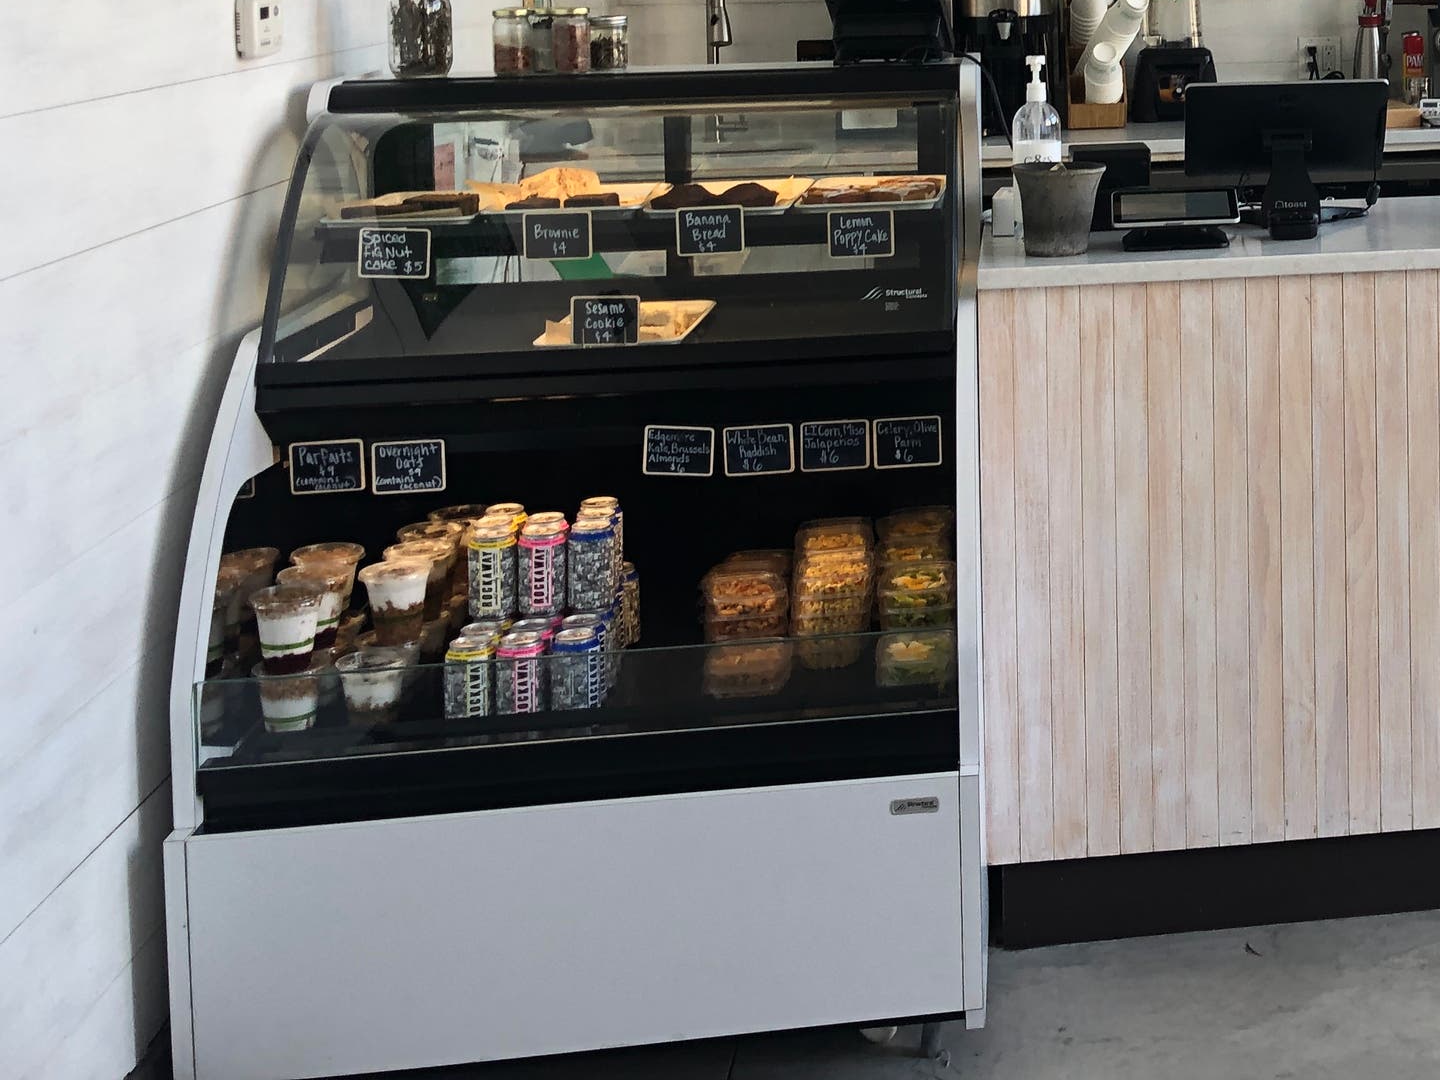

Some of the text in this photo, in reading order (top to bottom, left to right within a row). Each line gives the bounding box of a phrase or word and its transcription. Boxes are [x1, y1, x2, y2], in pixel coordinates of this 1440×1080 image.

[685, 211, 731, 228] Banana
[840, 216, 874, 229] Lemon
[534, 223, 580, 240] Brownie
[692, 226, 727, 241] Bread
[864, 228, 889, 244] Cake
[385, 245, 413, 259] Nut
[403, 260, 424, 275] $5
[885, 287, 922, 297] Structural
[585, 301, 625, 315] Sesame
[585, 317, 625, 330] Cookie
[914, 420, 938, 434] Olive
[727, 430, 757, 445] White
[379, 443, 438, 459] Overnight
[671, 442, 710, 454] Brussels
[739, 444, 777, 459] Raddish
[298, 446, 353, 467] Parfaits
[395, 456, 425, 470] Oats
[648, 453, 690, 464] Almonds
[482, 551, 493, 608] ROCKAWAY
[533, 549, 546, 605] ROCKAWAY
